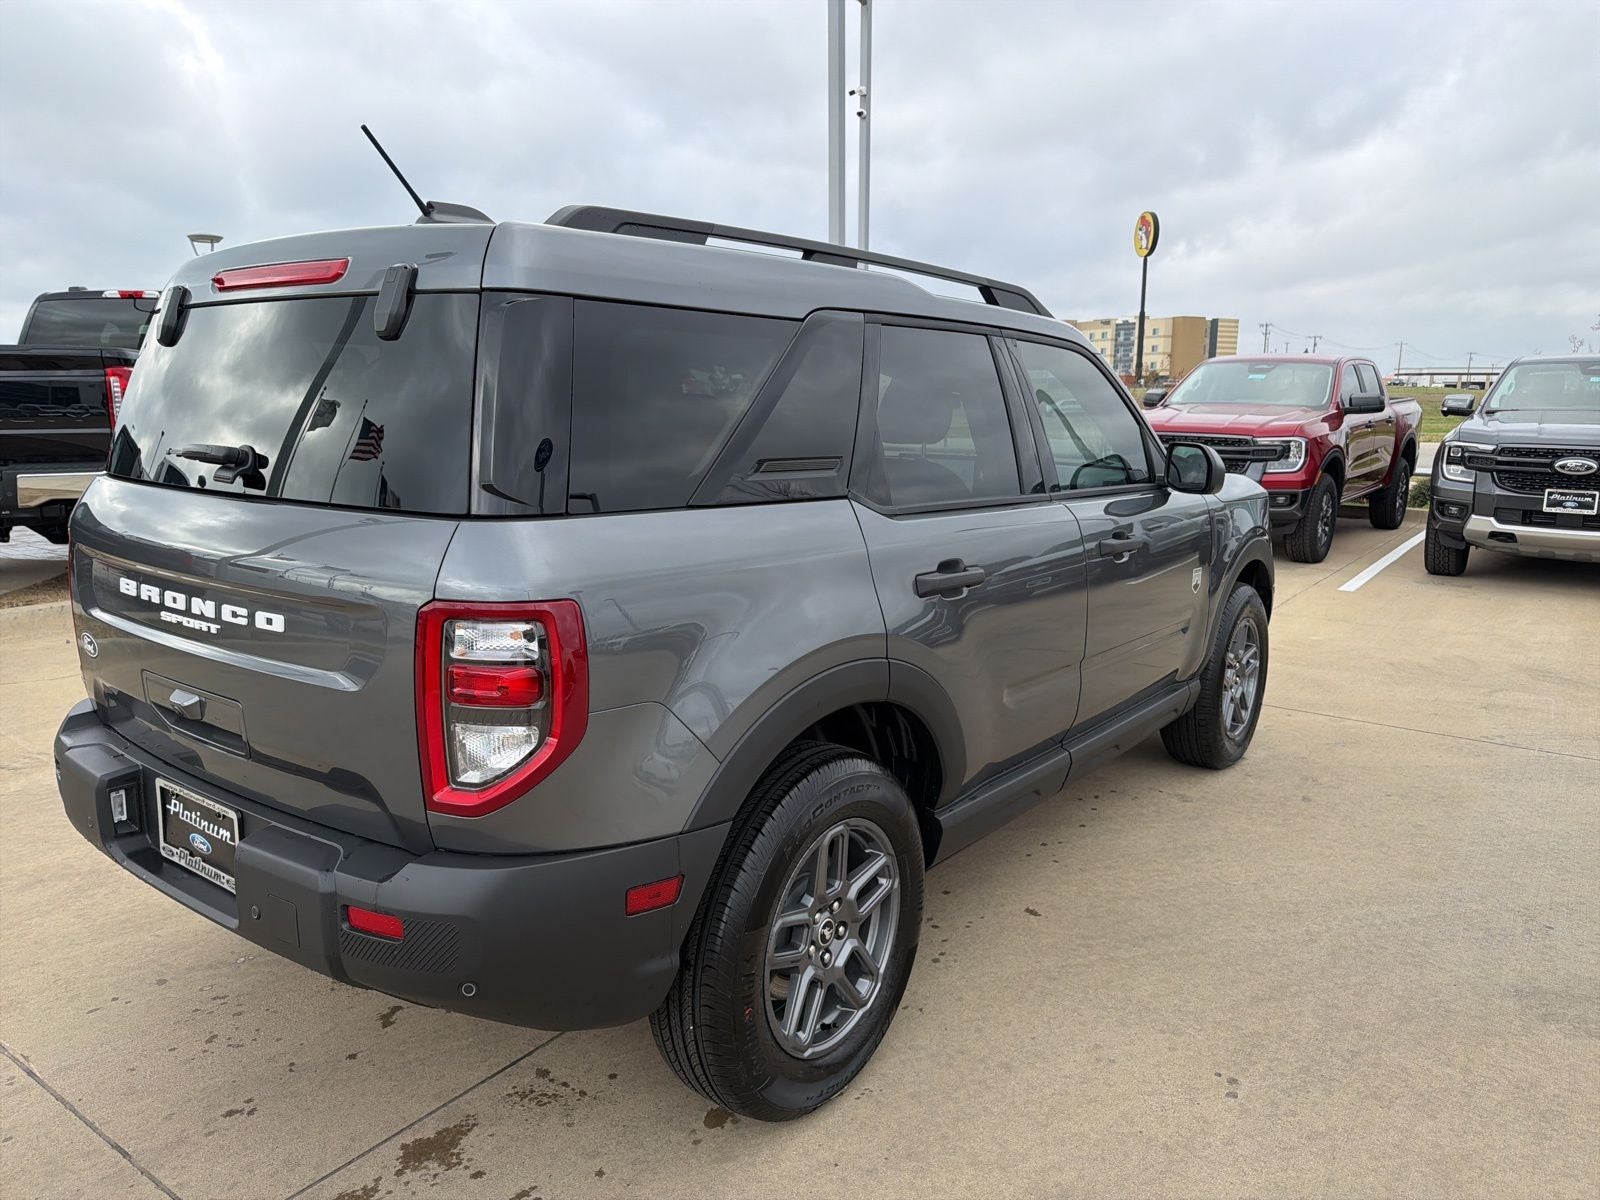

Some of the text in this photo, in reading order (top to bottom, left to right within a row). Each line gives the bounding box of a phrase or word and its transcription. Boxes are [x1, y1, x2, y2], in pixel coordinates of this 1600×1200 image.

[1564, 462, 1588, 472] Ford
[1549, 493, 1595, 502] Platinum
[119, 577, 286, 633] BRONCO
[159, 610, 222, 635] SPORT
[165, 798, 236, 846] Platinum
[191, 835, 208, 853] Ford
[178, 847, 225, 886] Platinum
